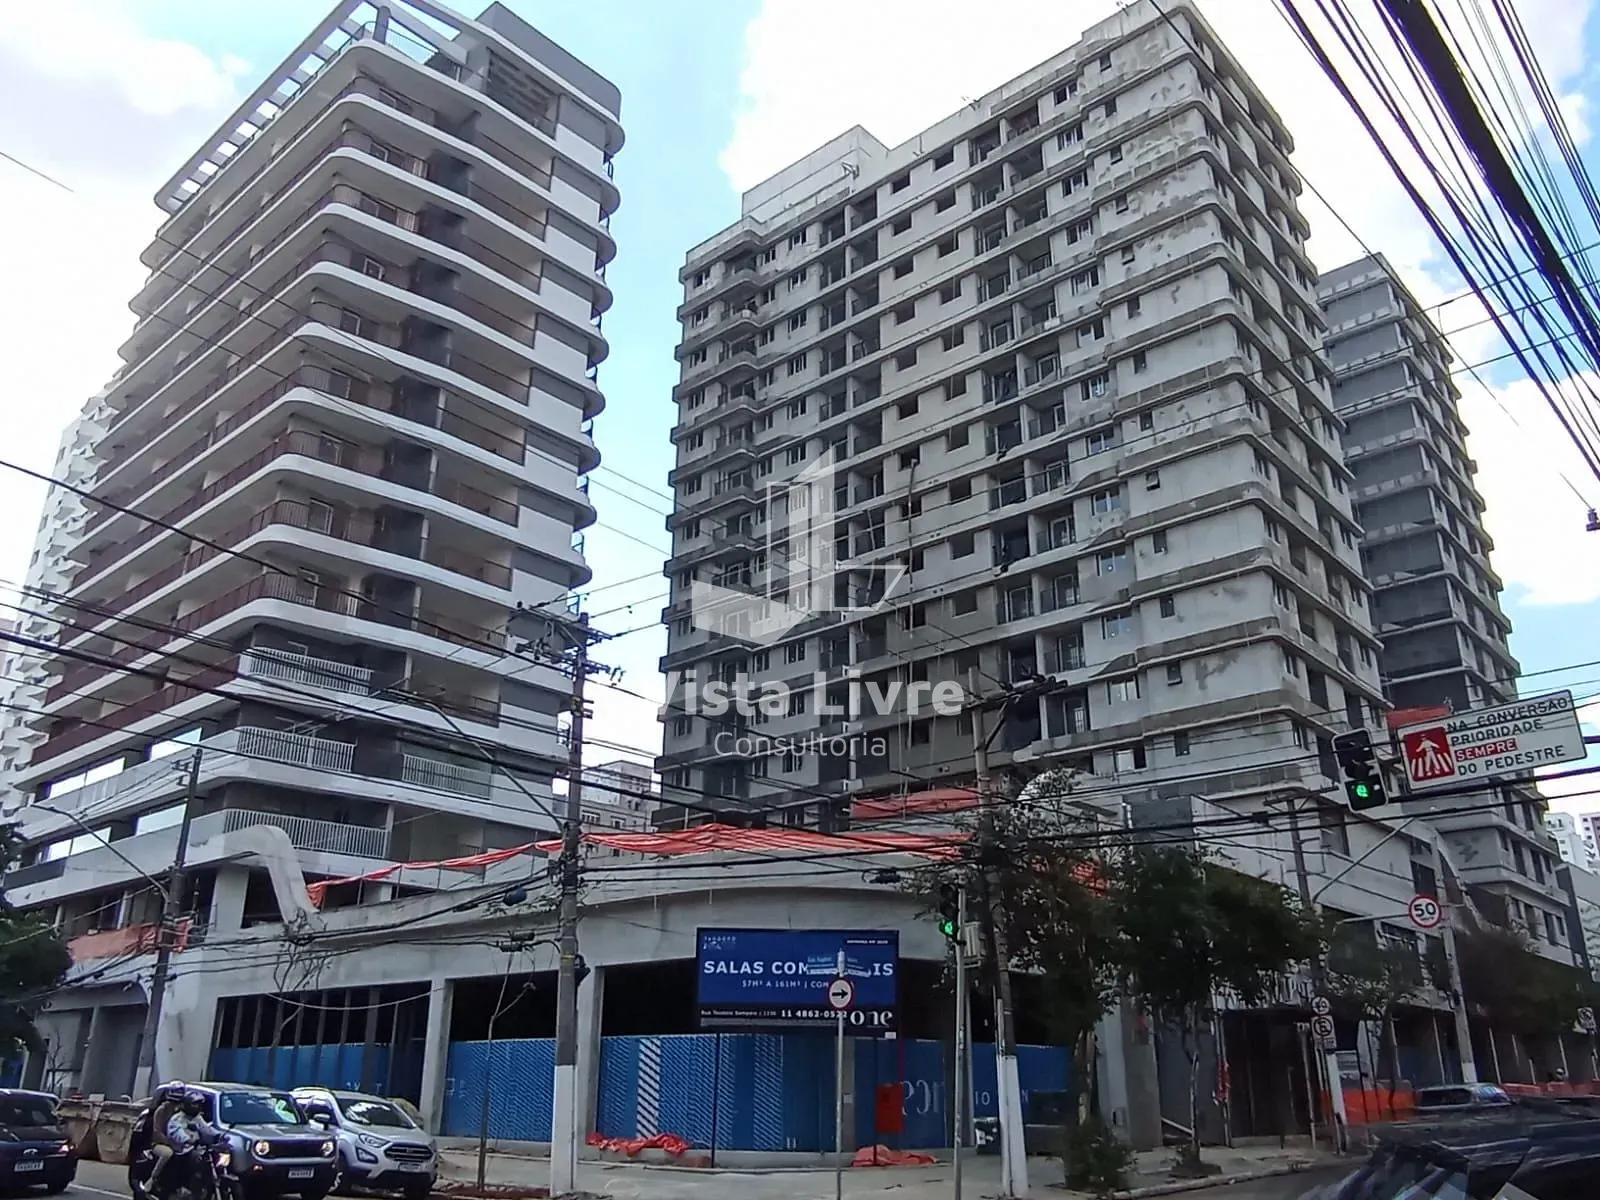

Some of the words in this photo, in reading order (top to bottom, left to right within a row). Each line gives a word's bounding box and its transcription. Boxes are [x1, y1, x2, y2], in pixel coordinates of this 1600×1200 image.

[1447, 720, 1468, 732] NA
[1451, 719, 1544, 746] PRIORIDADE
[1456, 739, 1517, 761] SEMPRE
[1458, 763, 1478, 776] DO
[1485, 745, 1566, 771] PEDESTRE
[1414, 902, 1436, 917] 50
[703, 960, 764, 975] SALAS
[850, 1010, 893, 1026] one
